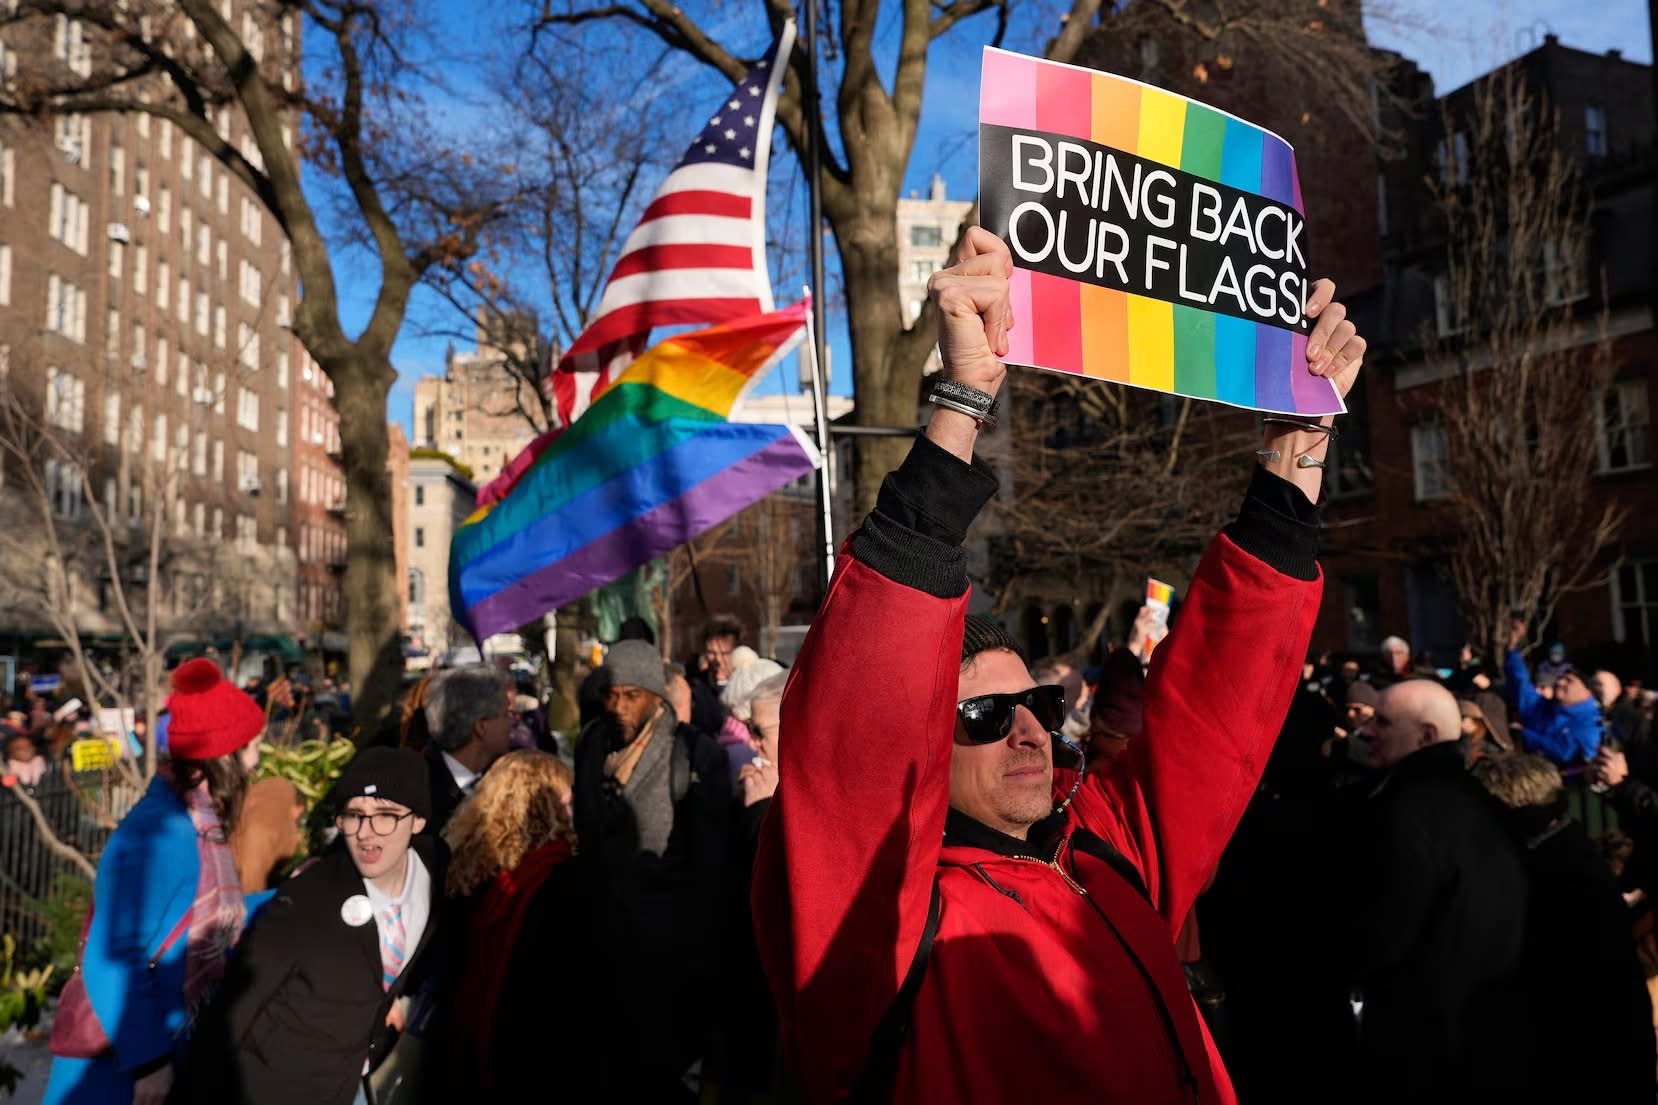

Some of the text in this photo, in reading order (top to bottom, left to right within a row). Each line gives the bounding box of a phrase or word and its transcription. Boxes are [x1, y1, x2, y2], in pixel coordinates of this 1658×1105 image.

[1008, 201, 1308, 329] OUR FLAGS!
[1011, 134, 1307, 269] BRING BACK
